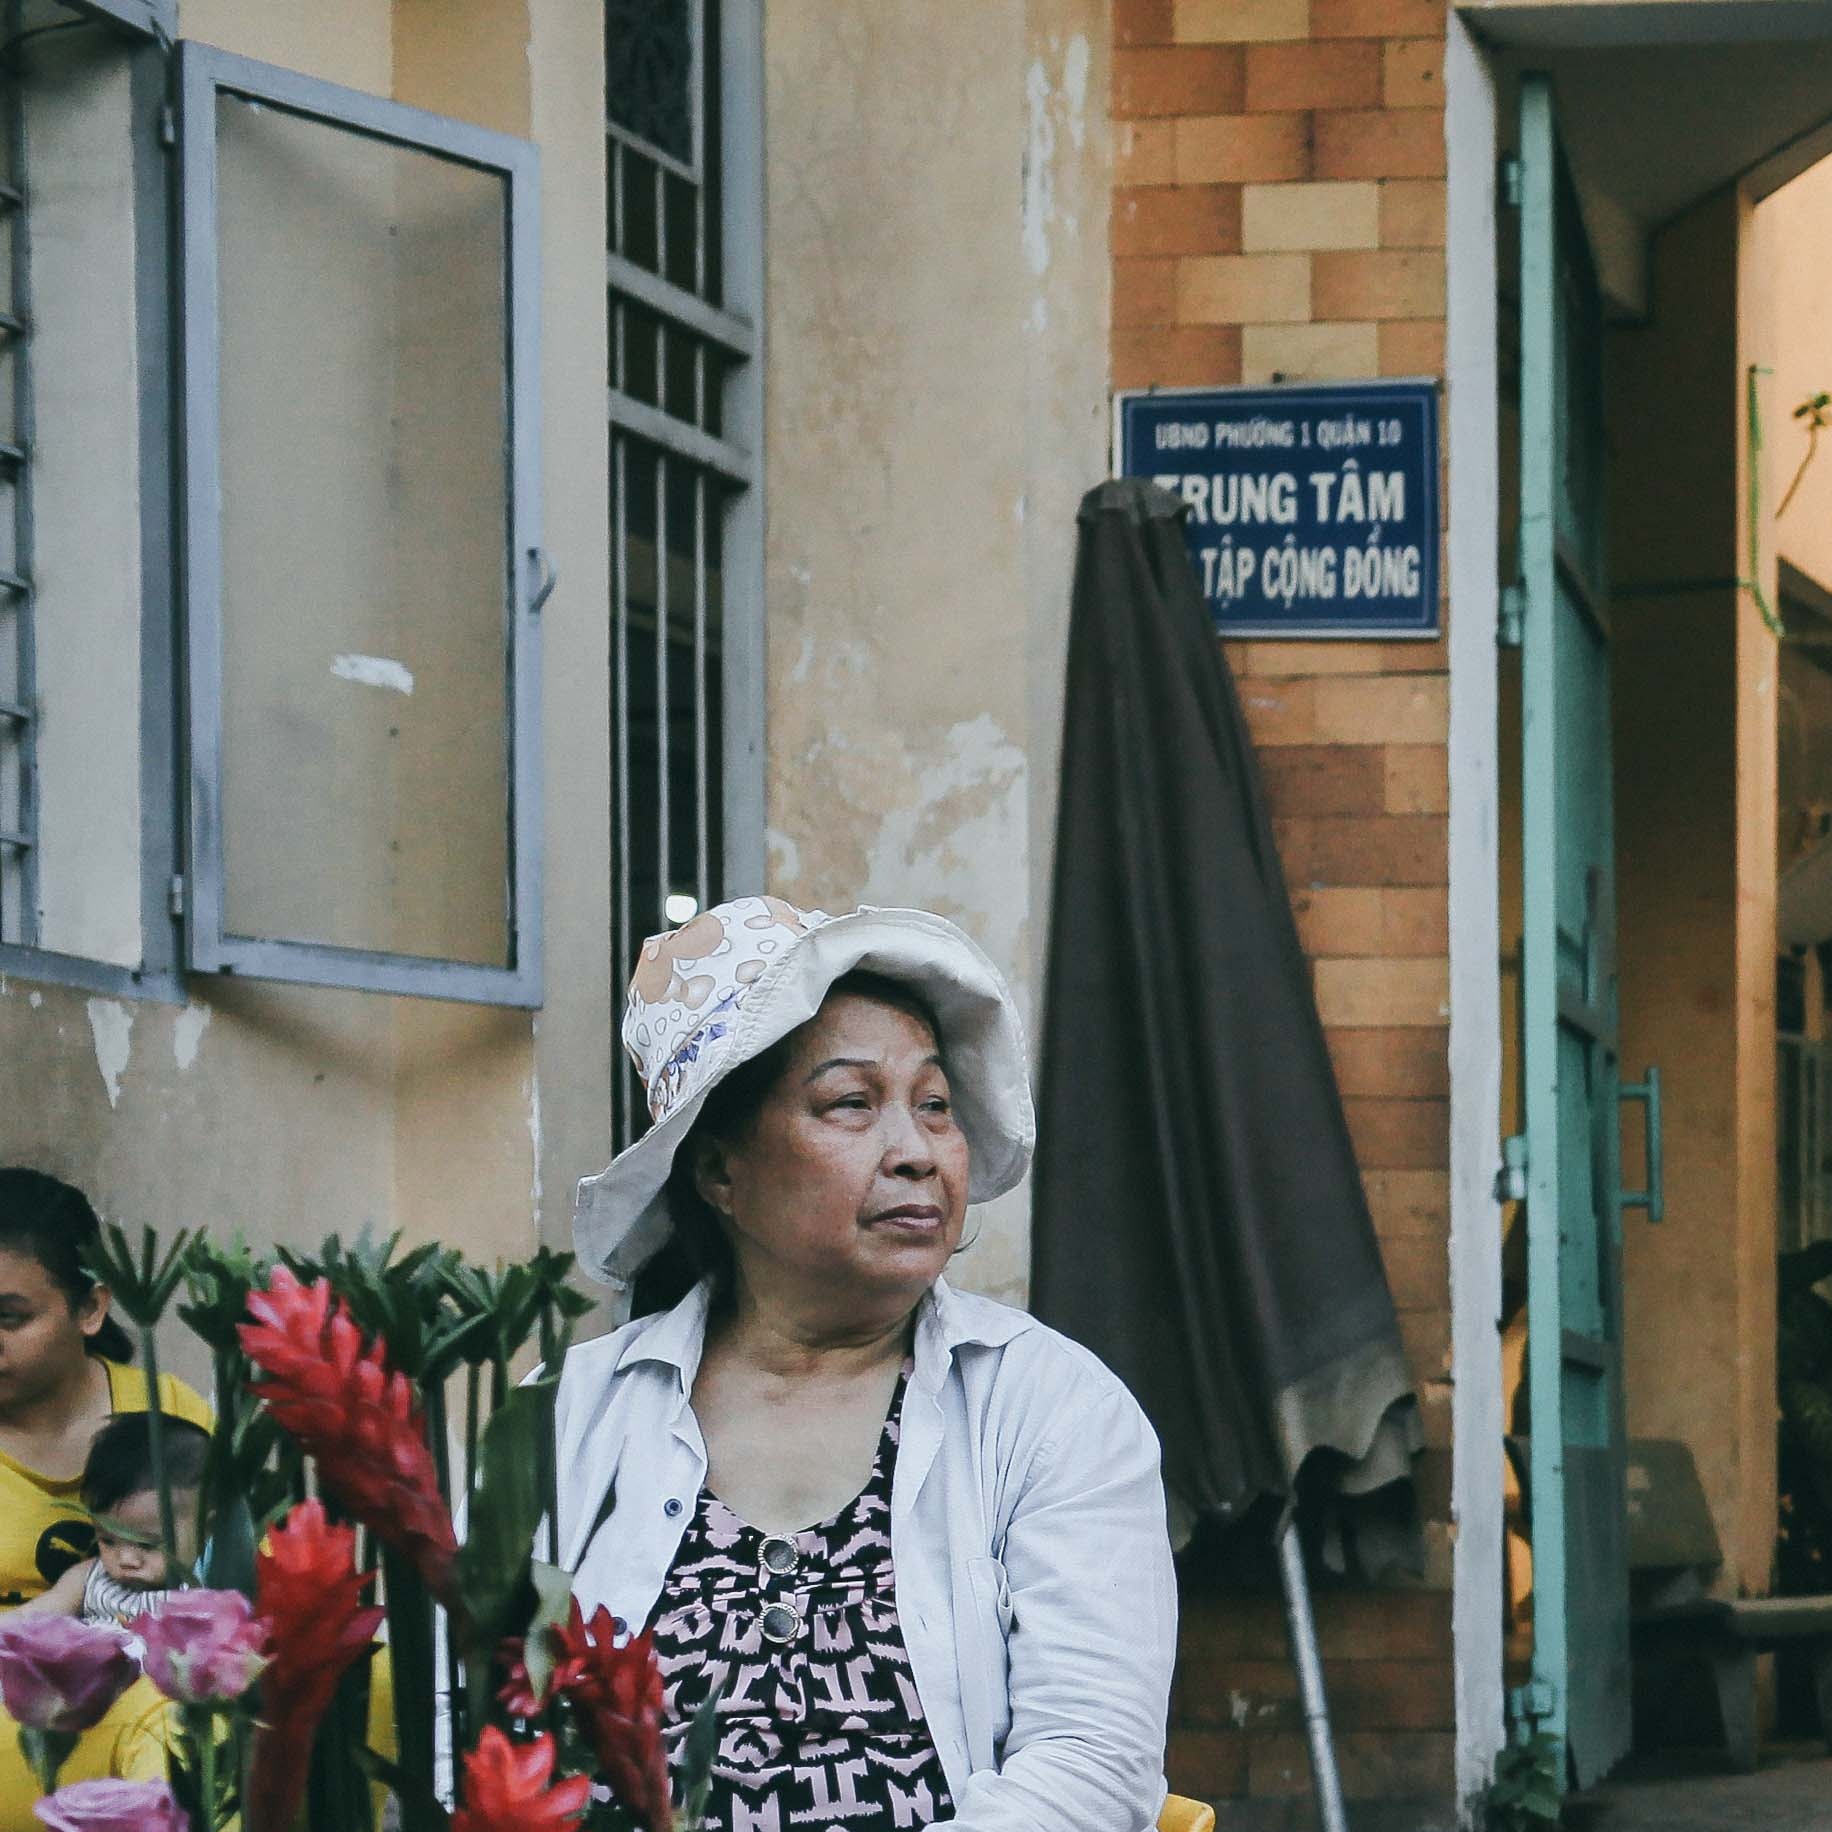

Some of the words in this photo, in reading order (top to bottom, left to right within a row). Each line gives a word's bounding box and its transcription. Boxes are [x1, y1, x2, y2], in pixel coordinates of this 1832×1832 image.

[1309, 457, 1405, 523] TÂM
[1201, 533, 1256, 609] TẬP
[1262, 533, 1337, 609] CỘNG
